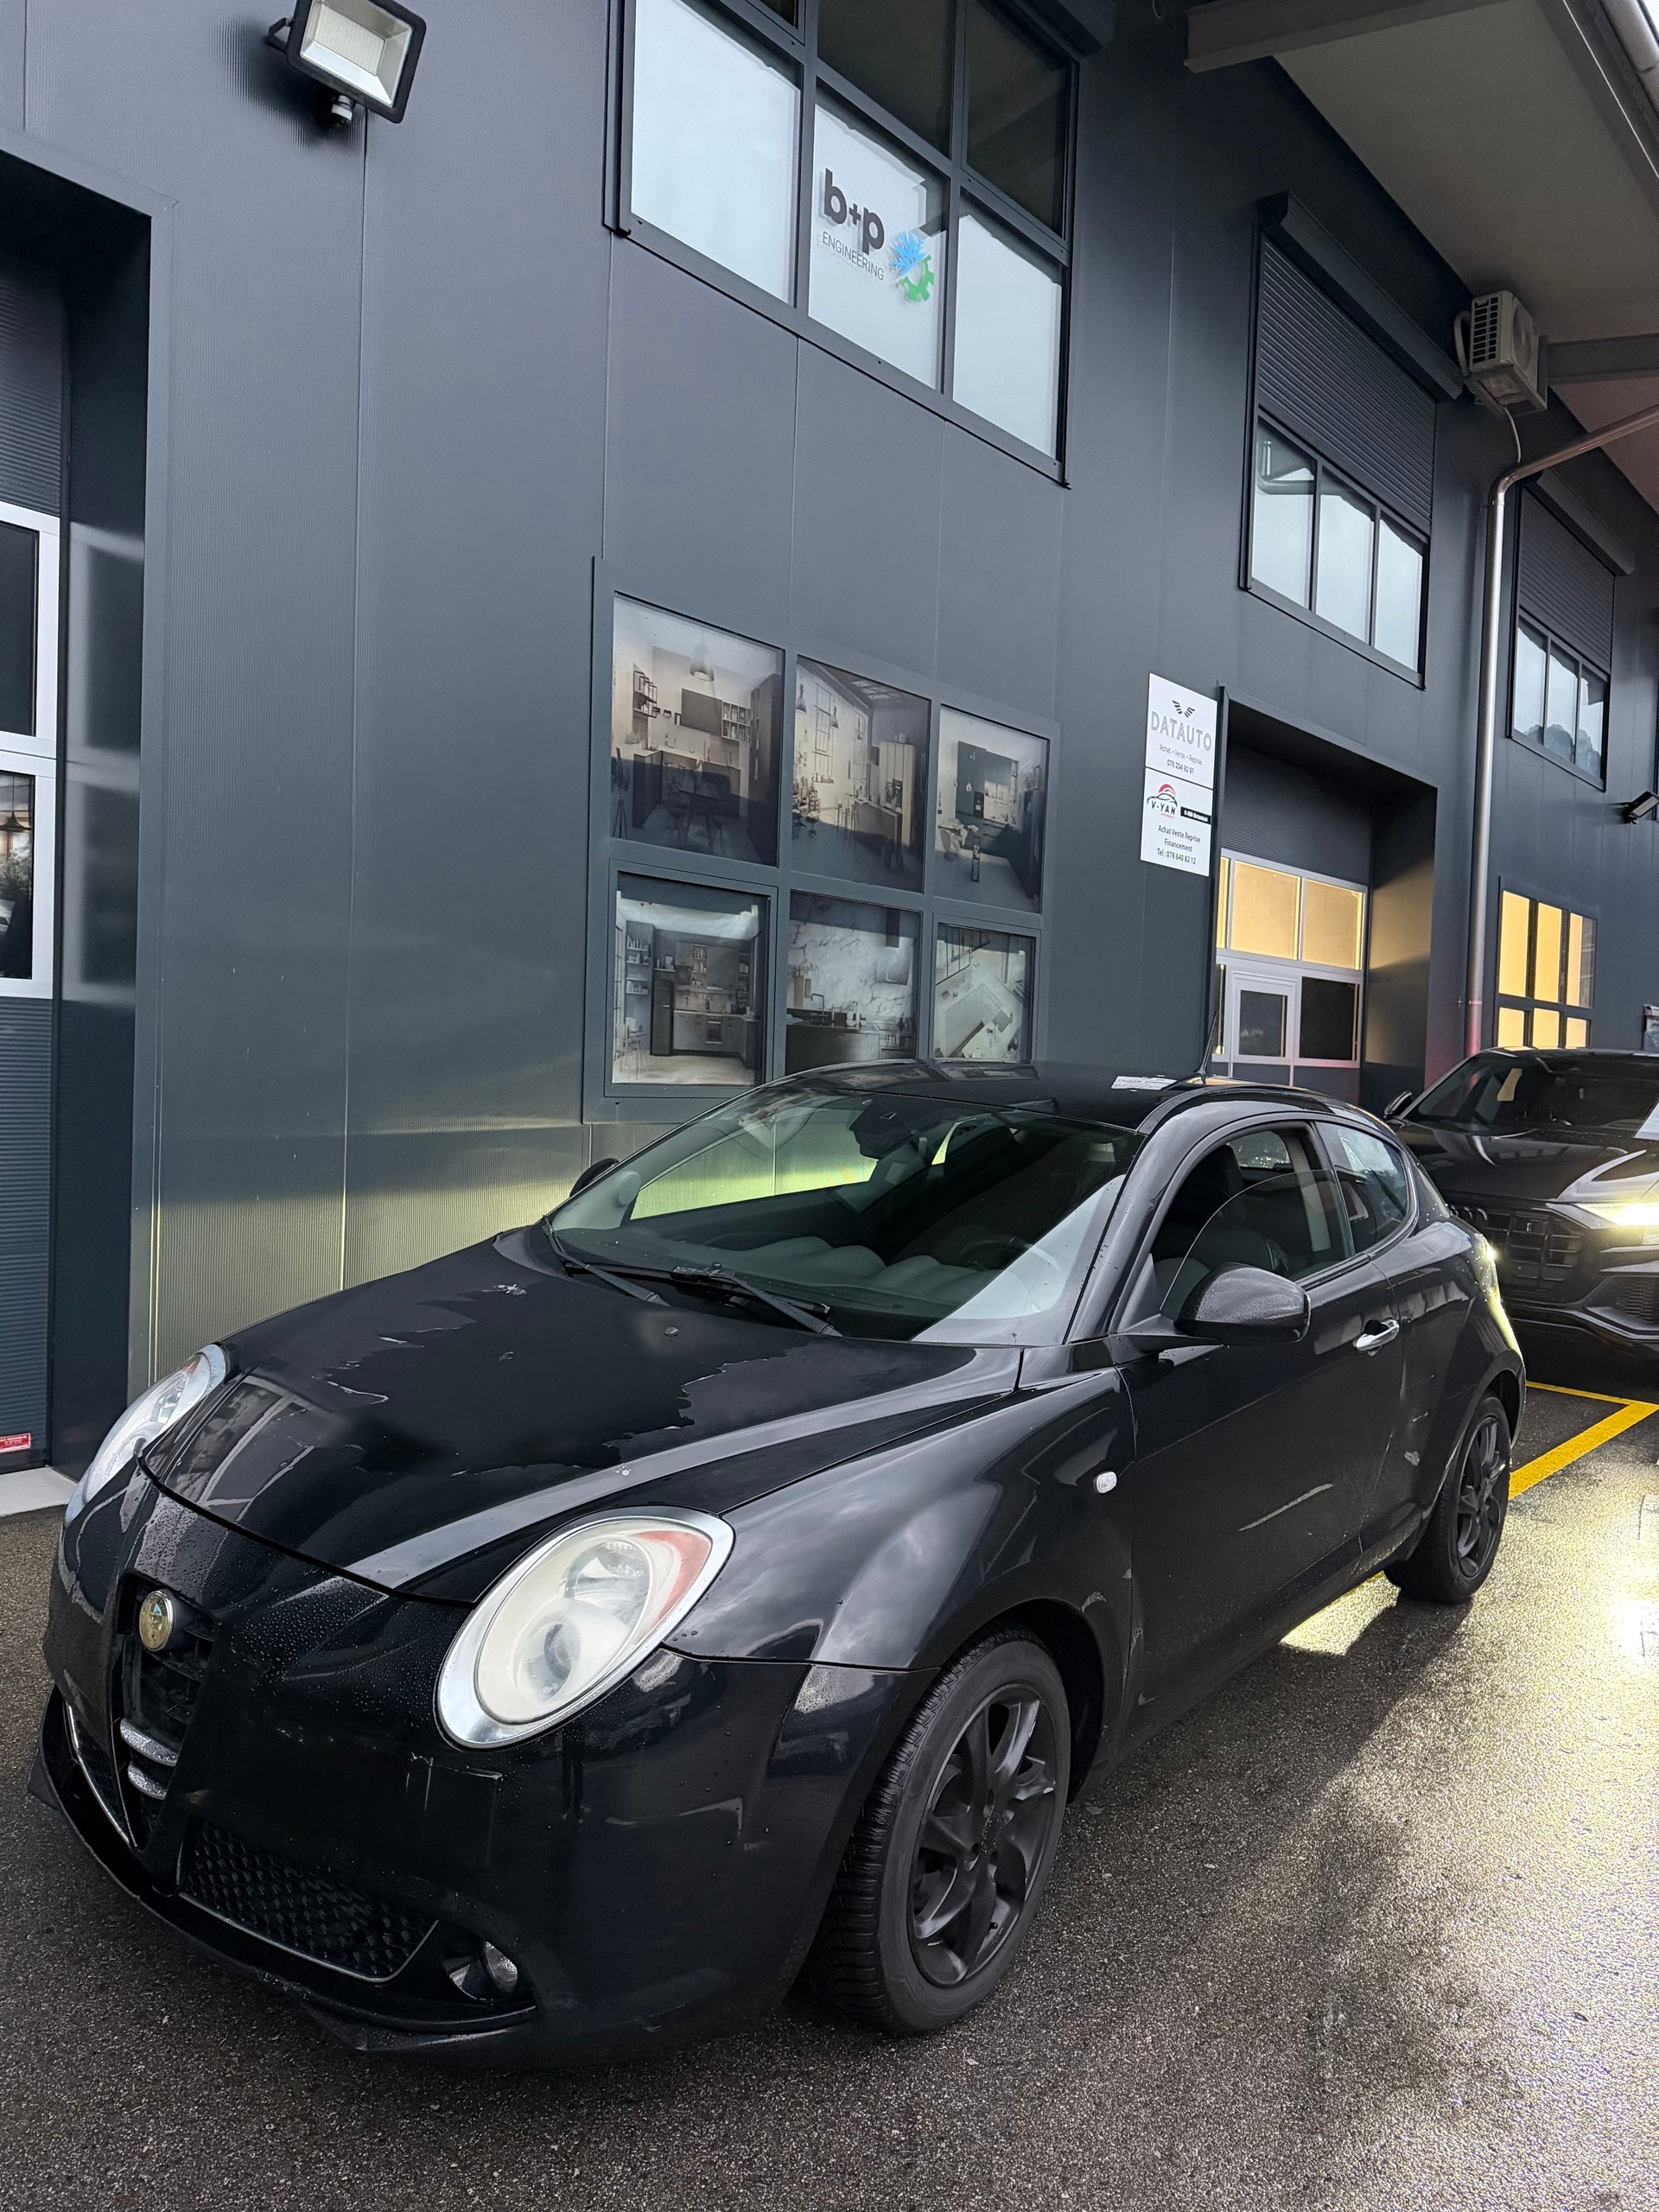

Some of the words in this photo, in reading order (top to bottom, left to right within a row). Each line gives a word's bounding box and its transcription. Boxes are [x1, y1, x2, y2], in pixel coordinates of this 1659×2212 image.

[823, 231, 884, 281] ENGINEERING
[1151, 710, 1212, 752] DATAUTO
[1158, 824, 1171, 835] Achat
[1172, 828, 1184, 838] Vente
[1185, 831, 1201, 843] Reprise
[1164, 837, 1193, 852] Financement
